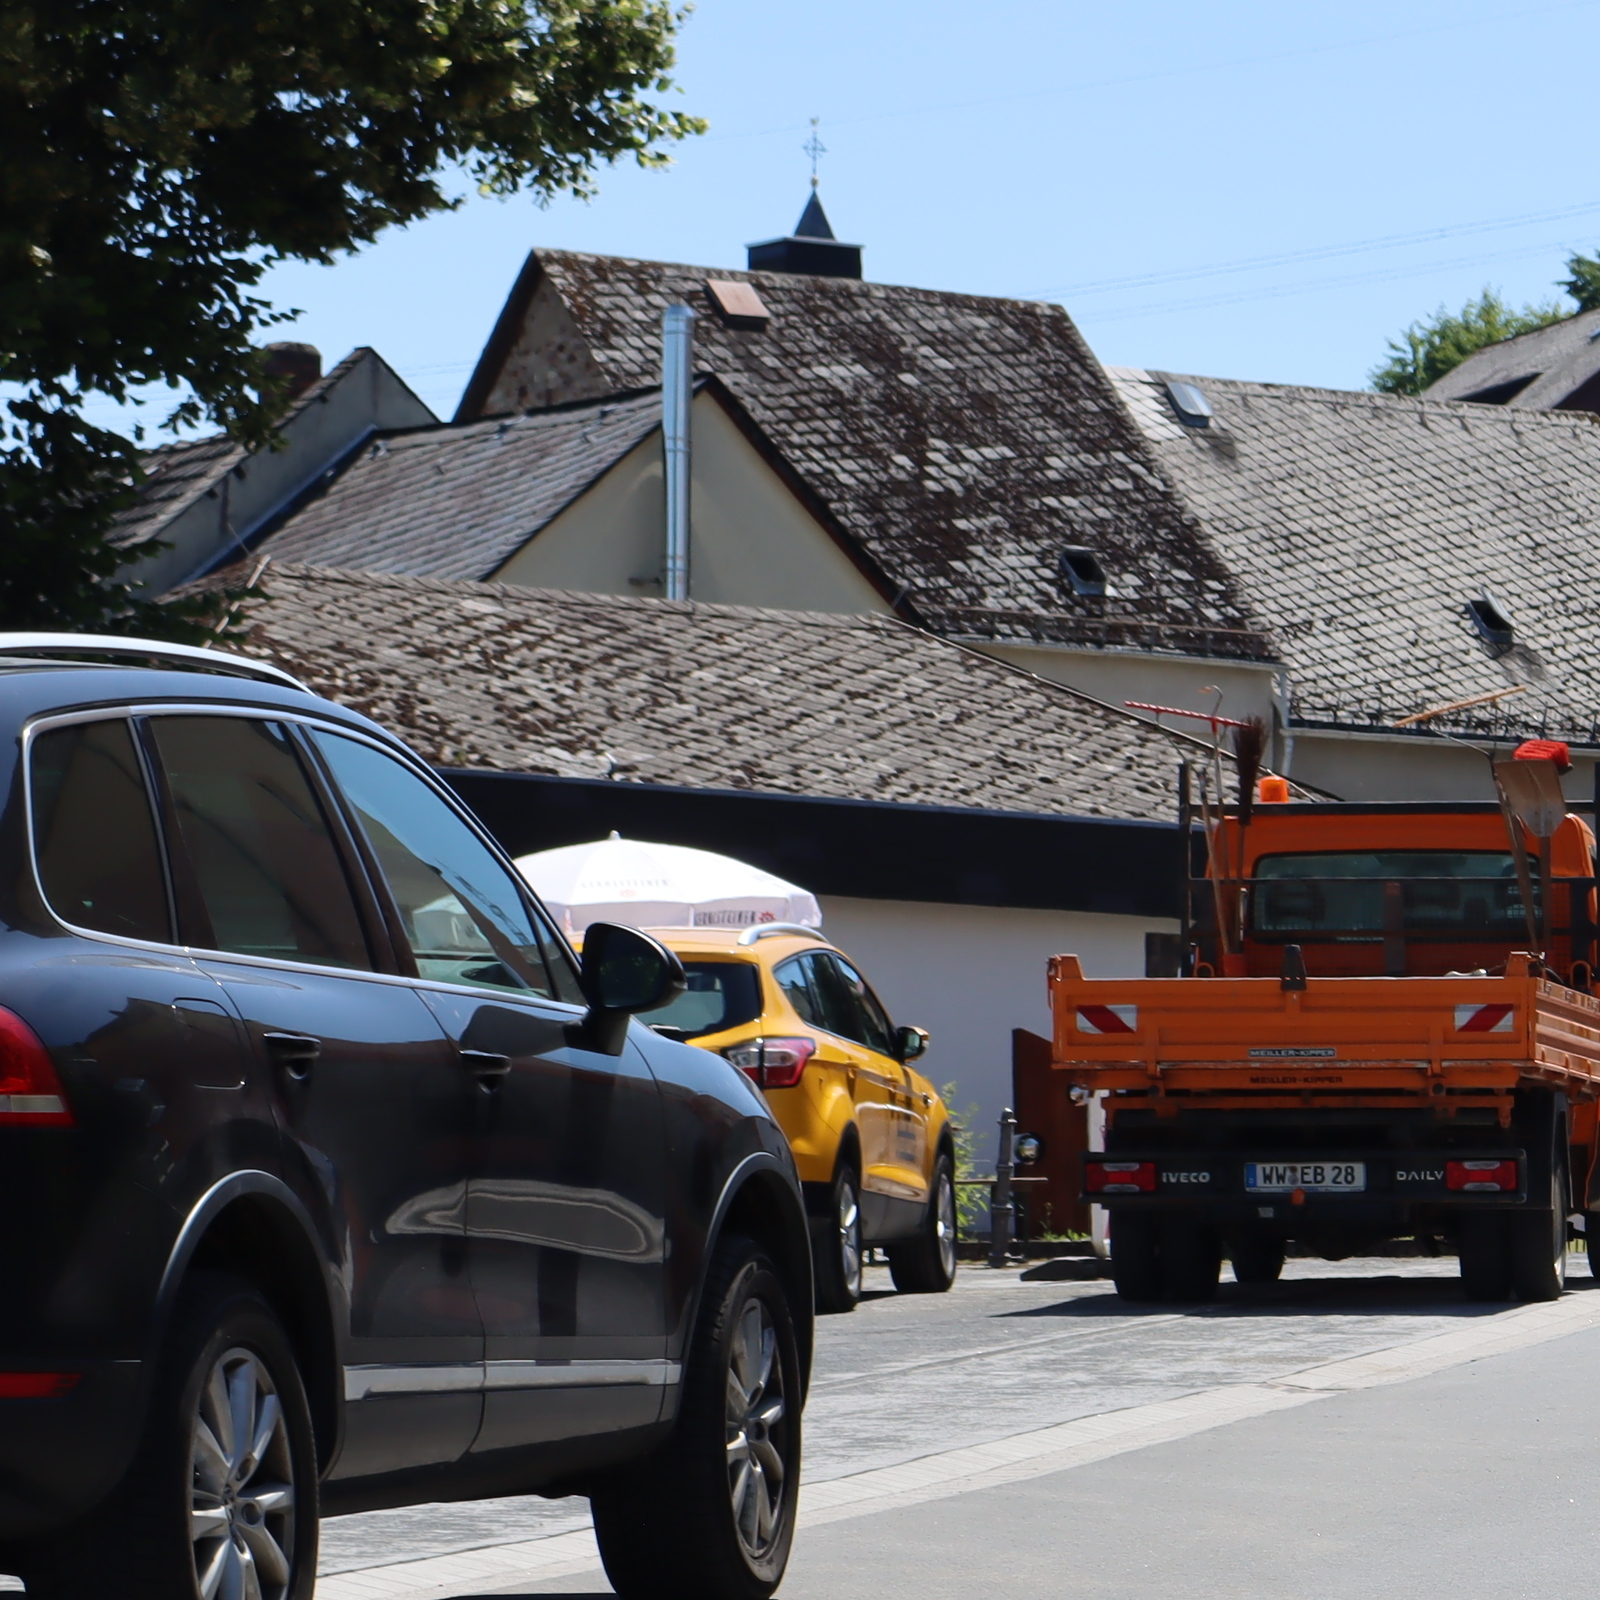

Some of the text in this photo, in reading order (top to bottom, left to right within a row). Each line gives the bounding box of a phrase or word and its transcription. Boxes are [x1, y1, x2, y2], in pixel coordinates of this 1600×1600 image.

[1162, 1172, 1211, 1183] IVECO
[1262, 1165, 1355, 1184] WW EB 28
